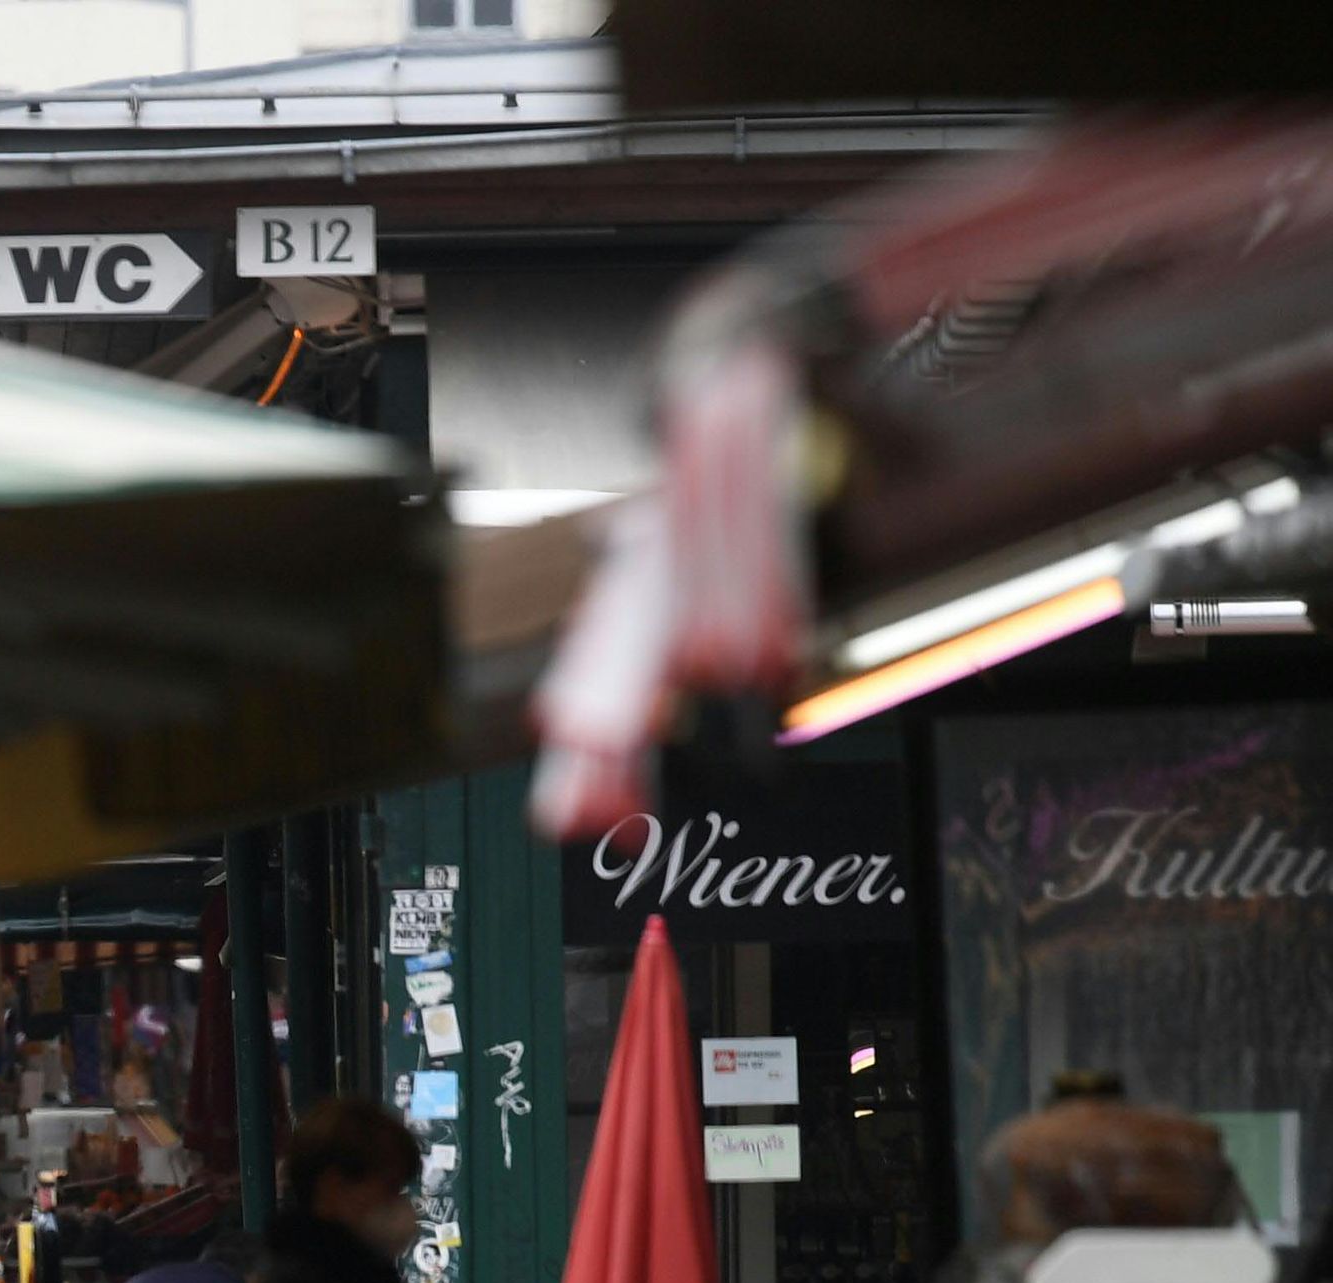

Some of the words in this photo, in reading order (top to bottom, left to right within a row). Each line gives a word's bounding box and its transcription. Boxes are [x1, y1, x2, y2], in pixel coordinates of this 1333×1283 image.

[10, 244, 153, 304] WC
[592, 810, 907, 910] Wiener.
[1042, 806, 1333, 900] Kultu
